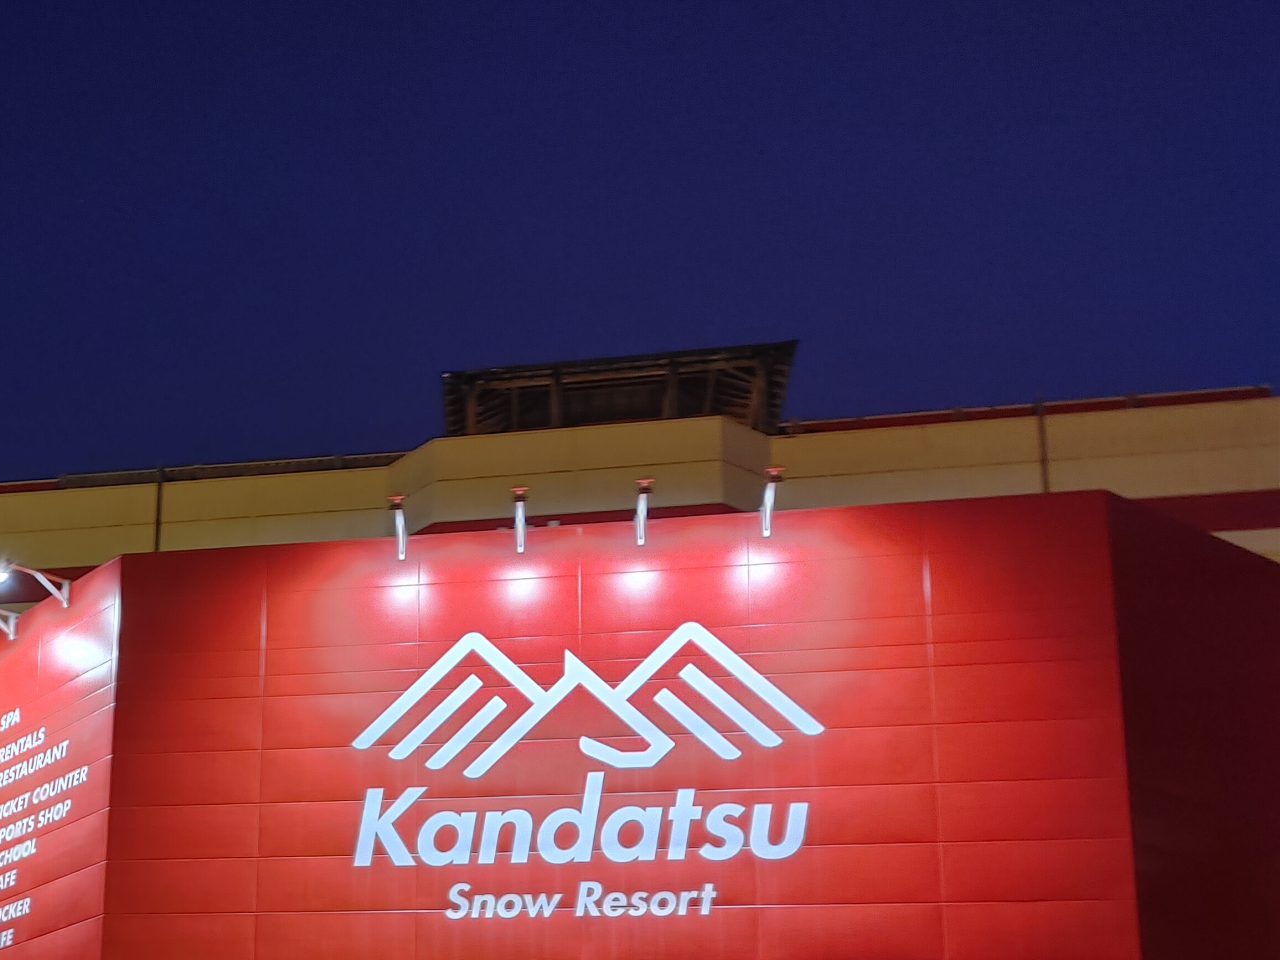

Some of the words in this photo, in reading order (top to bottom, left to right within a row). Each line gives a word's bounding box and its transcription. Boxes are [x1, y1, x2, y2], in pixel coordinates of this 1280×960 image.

[0, 708, 21, 732] SPA
[32, 765, 89, 805] COUNTER
[37, 799, 72, 828] SHOP
[352, 771, 809, 868] Kandatsu
[445, 881, 564, 920] Snow
[575, 880, 718, 918] Resort
